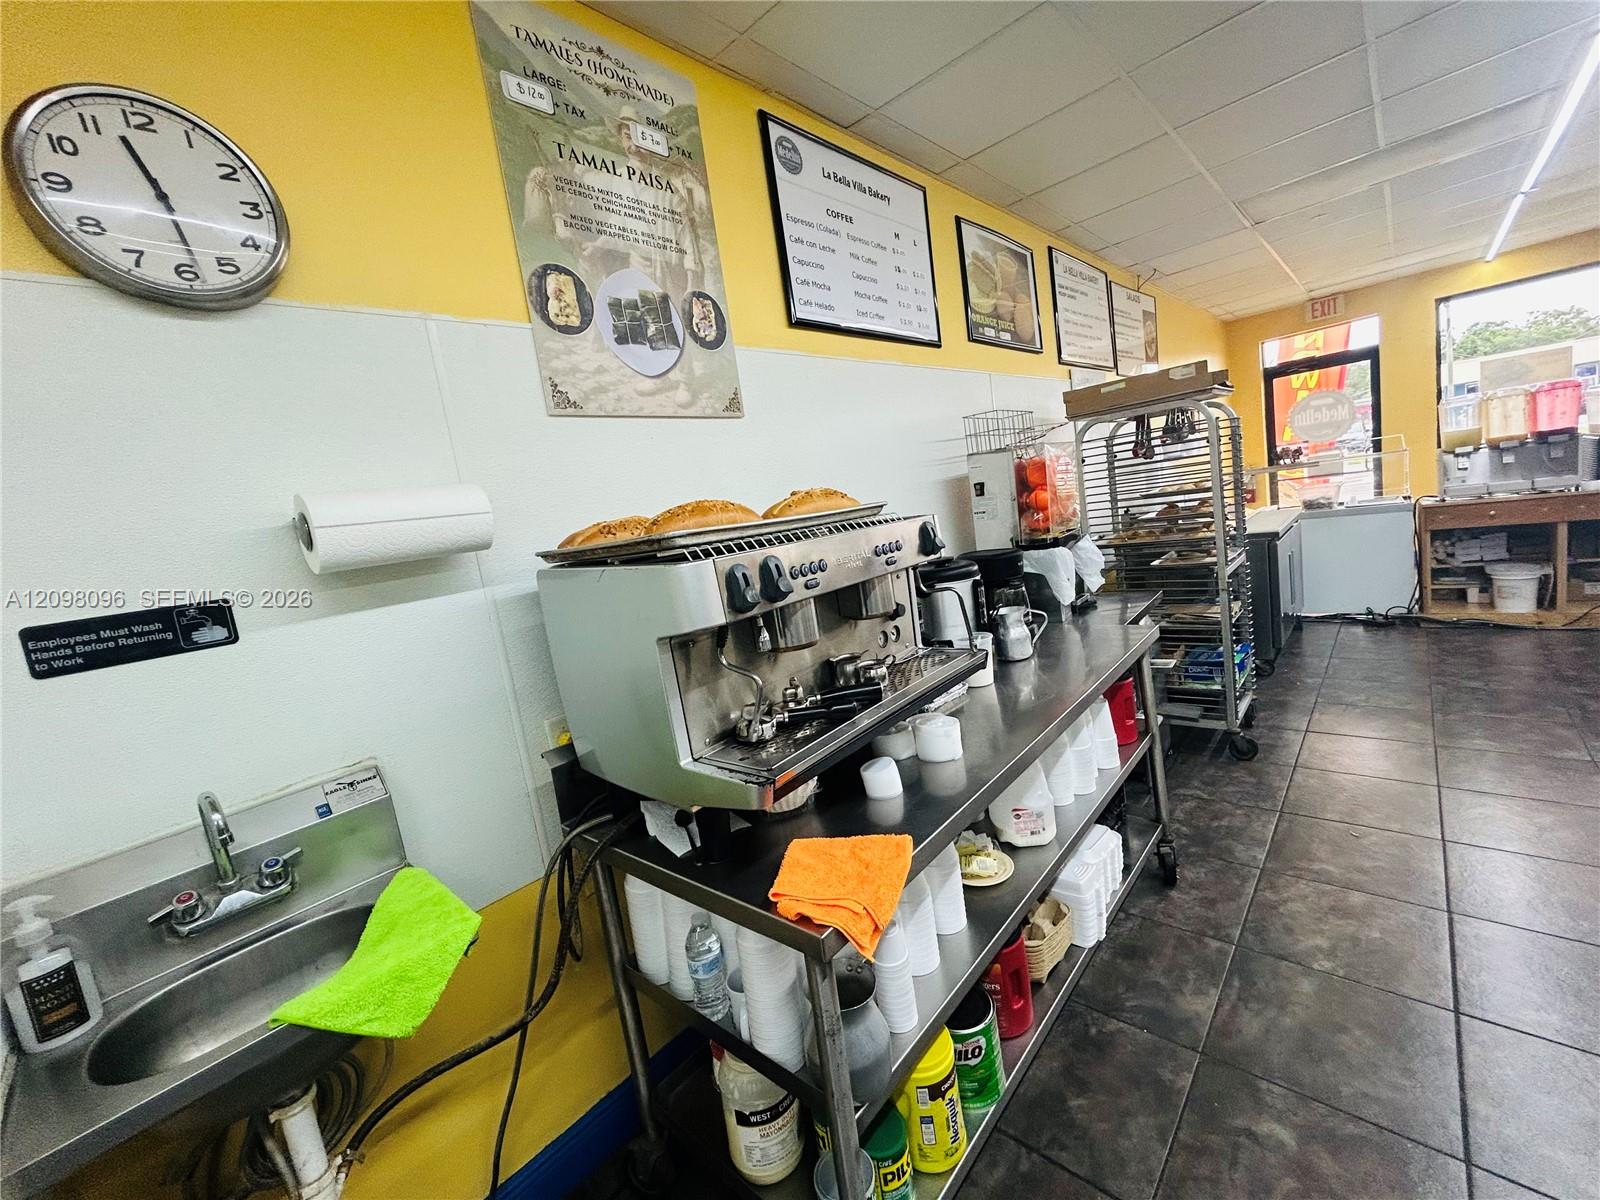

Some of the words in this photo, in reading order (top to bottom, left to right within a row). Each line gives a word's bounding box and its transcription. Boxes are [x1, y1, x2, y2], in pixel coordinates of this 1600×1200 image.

[510, 24, 583, 67] TAMALES
[587, 59, 674, 107] (HOMEMADE)
[523, 66, 567, 92] LARGE:
[120, 108, 159, 134] 12
[563, 102, 586, 120] TAX
[77, 111, 102, 136] 11
[646, 116, 679, 137] SMALL:
[47, 132, 79, 157] 10
[184, 129, 194, 149] 1
[675, 146, 693, 161] TAX
[215, 162, 241, 183] 2
[552, 140, 622, 177] TAMAL
[626, 165, 675, 194] PAISA
[40, 171, 73, 193] 9
[555, 184, 566, 193] DE
[567, 187, 593, 200] CERDO
[821, 166, 832, 180] La
[832, 171, 851, 188] Bella
[851, 179, 867, 195] Villa
[867, 186, 891, 206] Bakery
[553, 175, 596, 193] VEGETALES
[663, 207, 682, 218] CARNE
[239, 200, 264, 220] 3
[570, 213, 593, 225] MIXED
[593, 203, 603, 211] EN
[604, 206, 622, 216] MAIZ
[624, 211, 656, 225] AMARILLO
[826, 208, 854, 225] COFFEE
[76, 215, 108, 236] 8
[785, 213, 815, 229] Espresso
[239, 234, 262, 252] 4
[595, 227, 631, 242] WRAPPED
[632, 237, 640, 245] IN
[641, 239, 668, 251] YELLOW
[670, 245, 688, 255] CORN
[846, 232, 870, 246] Espresso
[870, 240, 887, 252] Coffee
[894, 232, 900, 240] M
[806, 240, 818, 249] con
[818, 243, 836, 255] Leche
[121, 248, 145, 269] 7
[215, 256, 241, 276] 5
[792, 255, 825, 271] Capuccino
[861, 255, 878, 266] Coffee
[173, 262, 201, 283] 6
[811, 280, 831, 291] Mocha
[871, 294, 888, 305] Coffee
[1311, 297, 1337, 319] EXIT
[869, 311, 886, 321] Coffee
[971, 312, 997, 327] ORANGE
[997, 319, 1015, 331] JUICE
[28, 632, 98, 650] Employees
[99, 627, 129, 640] Must
[131, 622, 163, 634] Wash
[30, 647, 73, 661] Hands
[75, 638, 116, 653] Before
[118, 630, 173, 646] Returning
[34, 663, 48, 672] to
[50, 657, 85, 669] Work
[325, 785, 347, 796] EAGLE
[356, 774, 377, 786] SINKS
[749, 1112, 771, 1123] WEST
[758, 1121, 780, 1133] HEAVY
